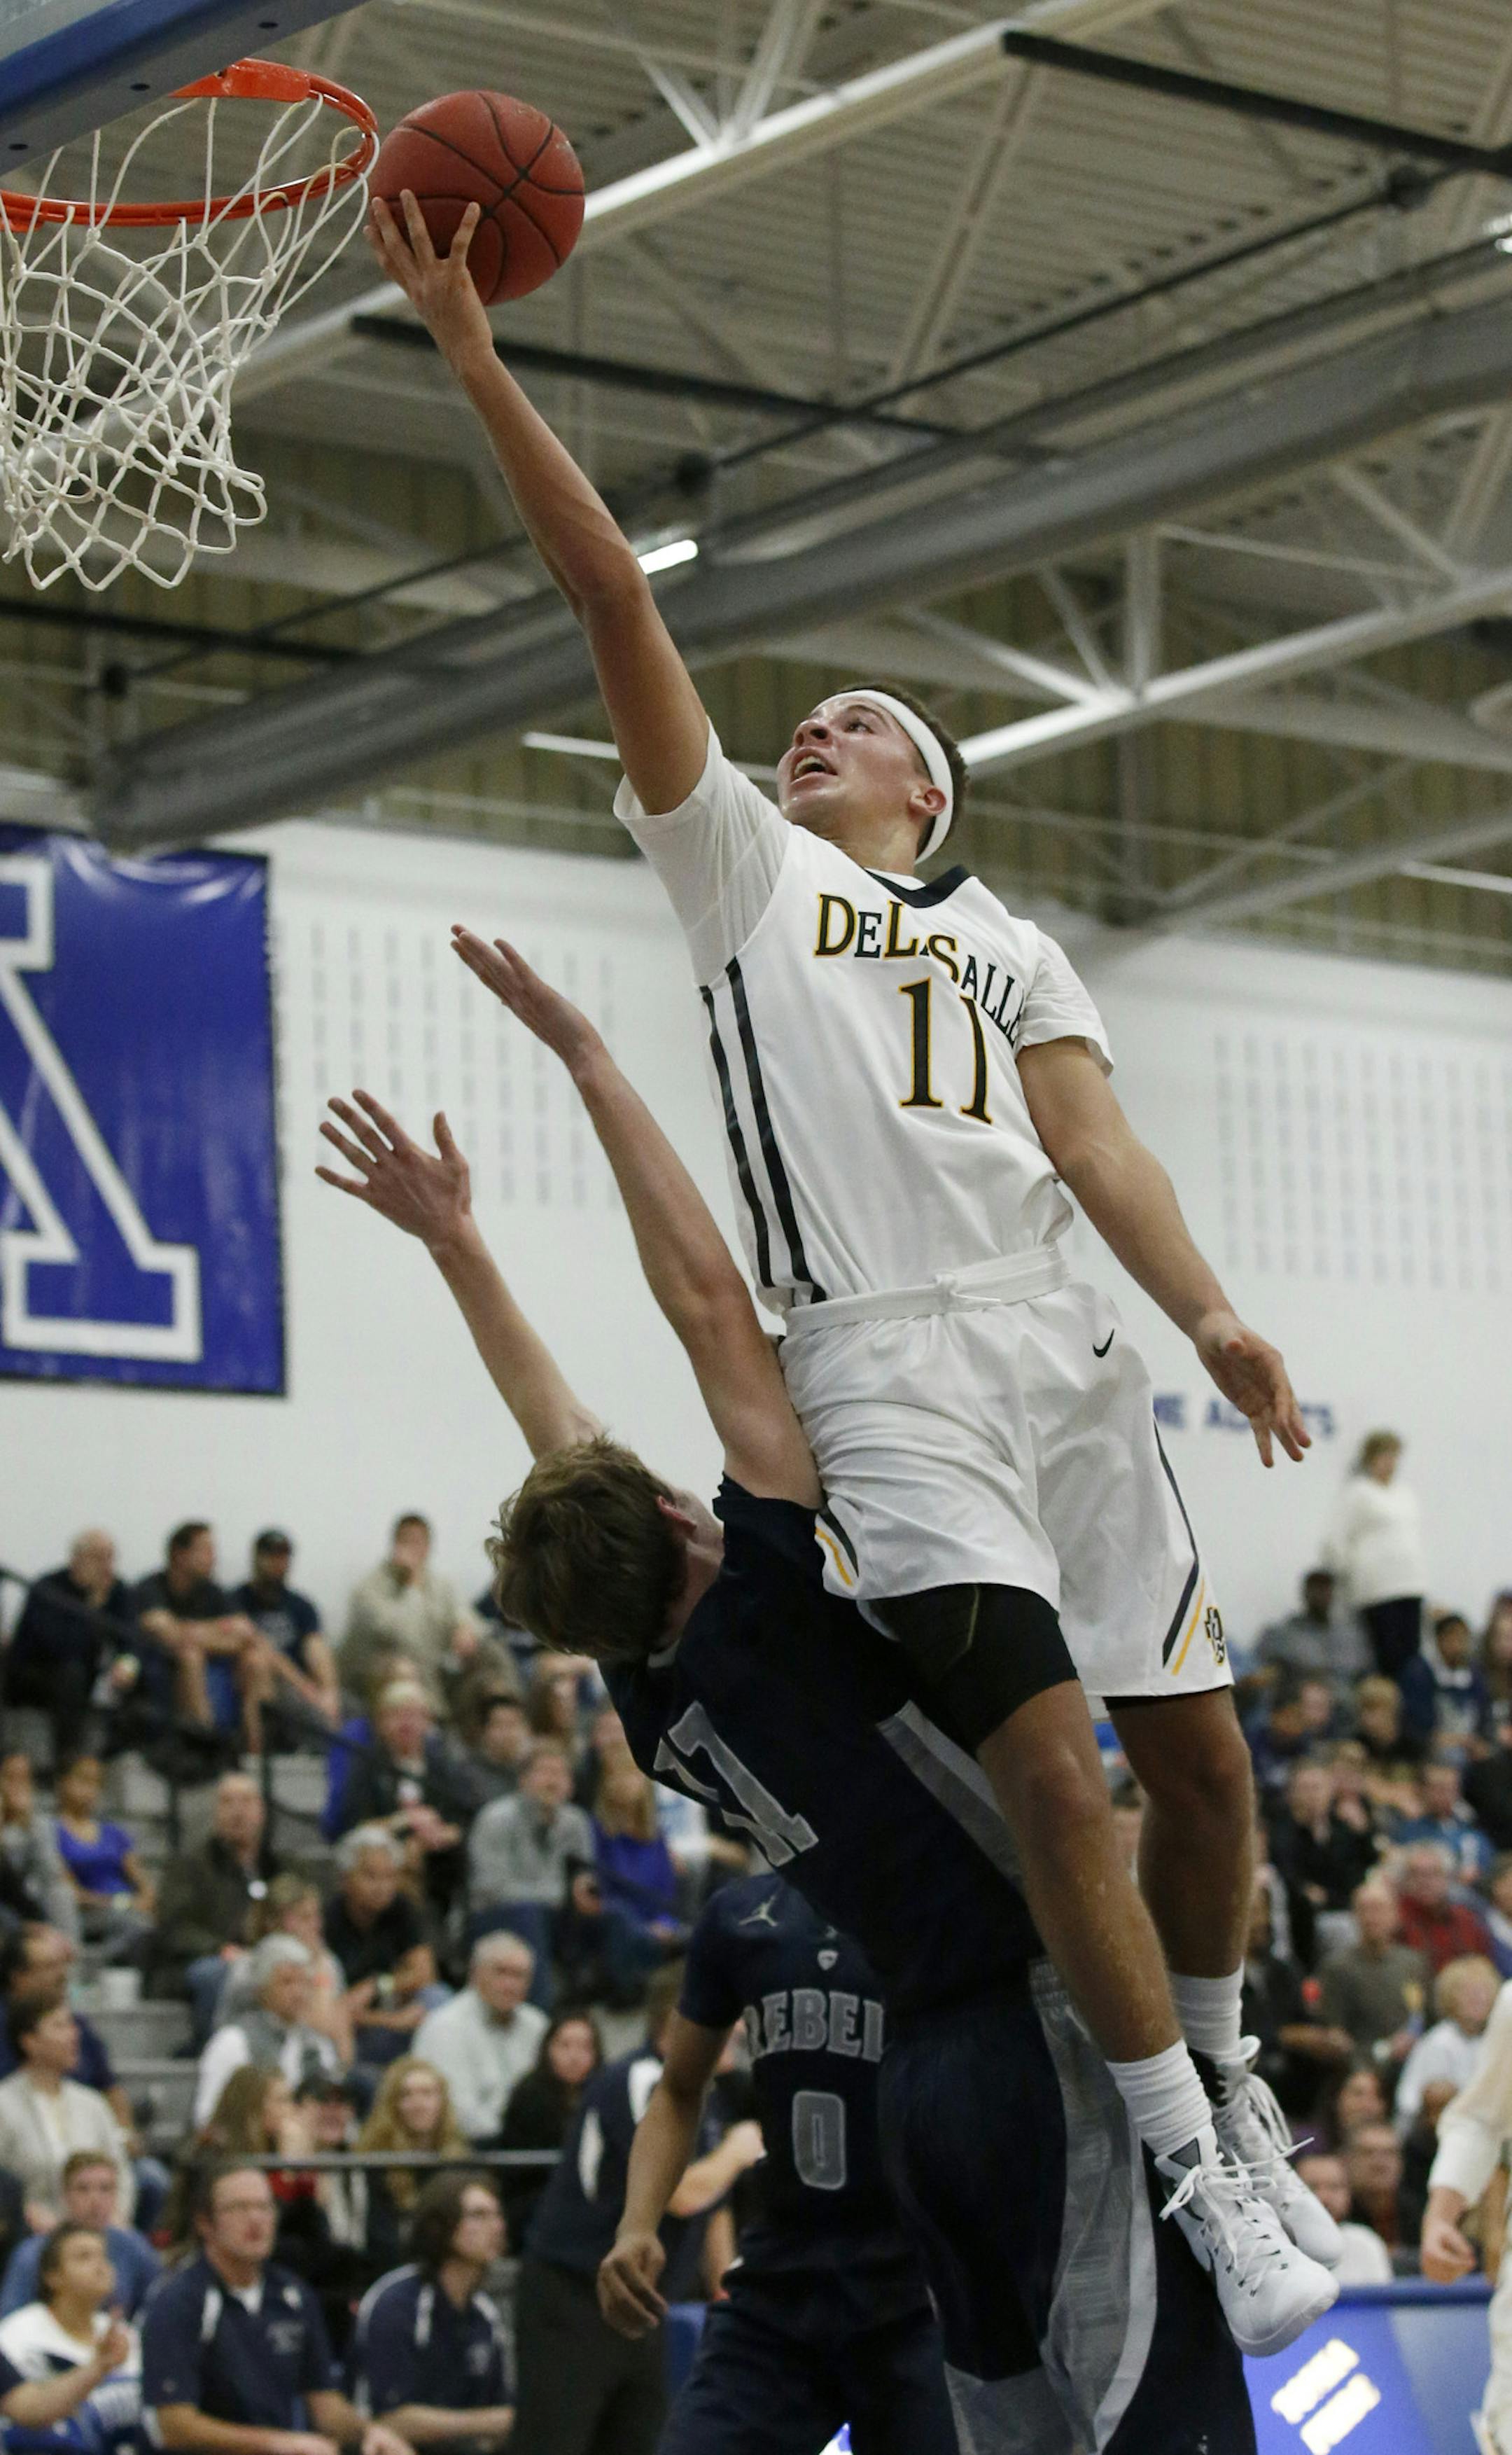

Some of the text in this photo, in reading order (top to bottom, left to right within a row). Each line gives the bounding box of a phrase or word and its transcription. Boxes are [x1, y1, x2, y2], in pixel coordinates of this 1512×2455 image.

[813, 893, 1025, 1049] DELSALLE
[898, 975, 993, 1125] 11
[792, 2089, 847, 2190] 0
